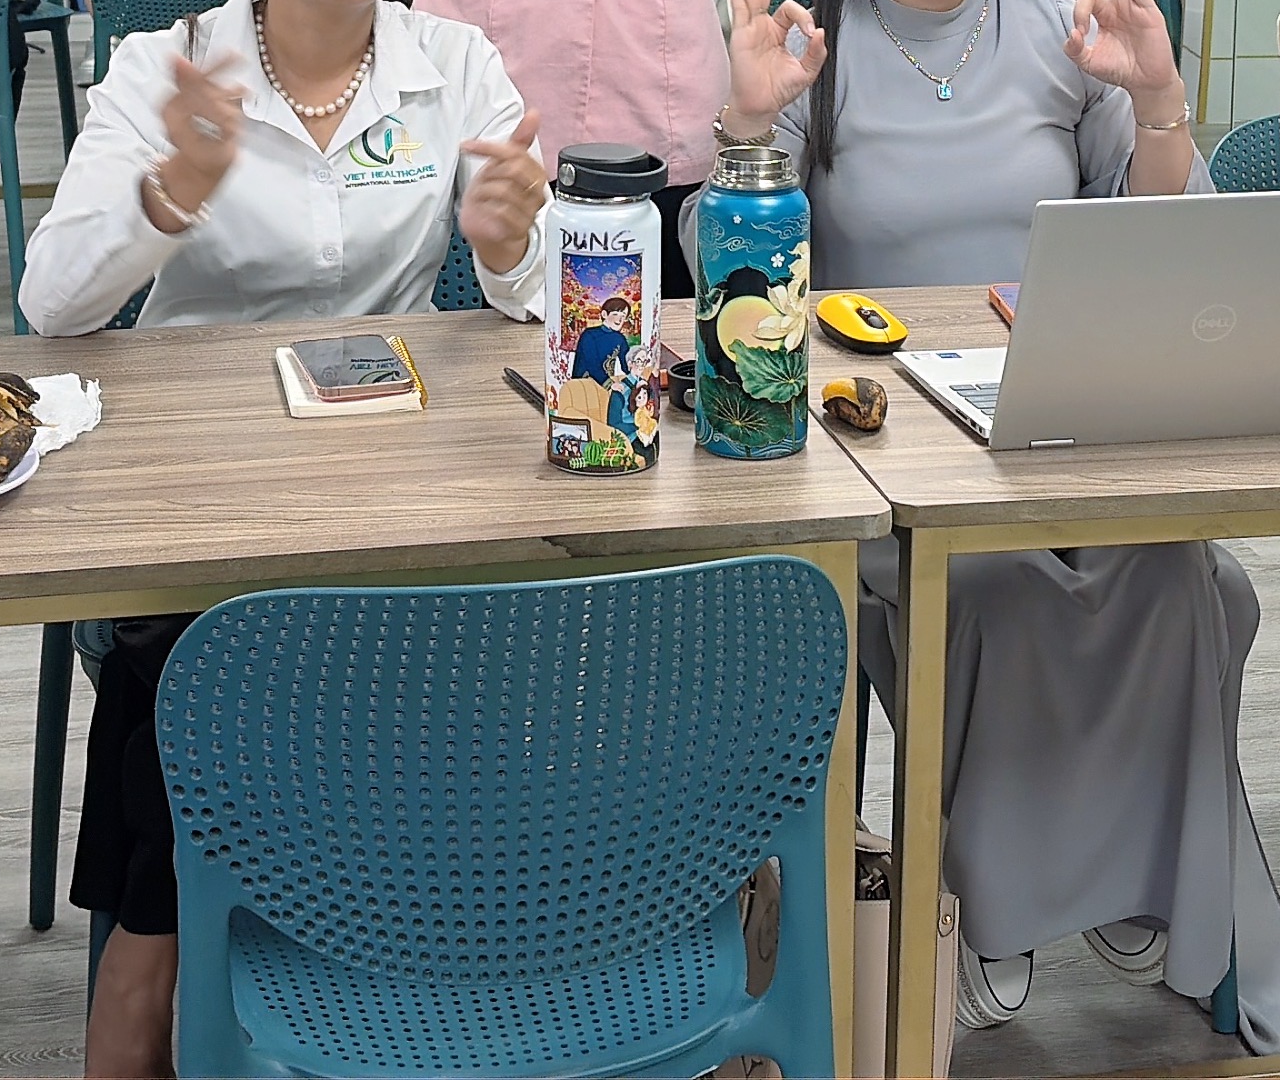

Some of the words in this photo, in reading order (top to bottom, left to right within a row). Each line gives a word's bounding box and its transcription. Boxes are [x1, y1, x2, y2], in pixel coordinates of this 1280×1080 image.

[343, 172, 366, 181] VIET
[372, 165, 435, 178] HEALTHCARE
[1197, 317, 1230, 330] DELL
